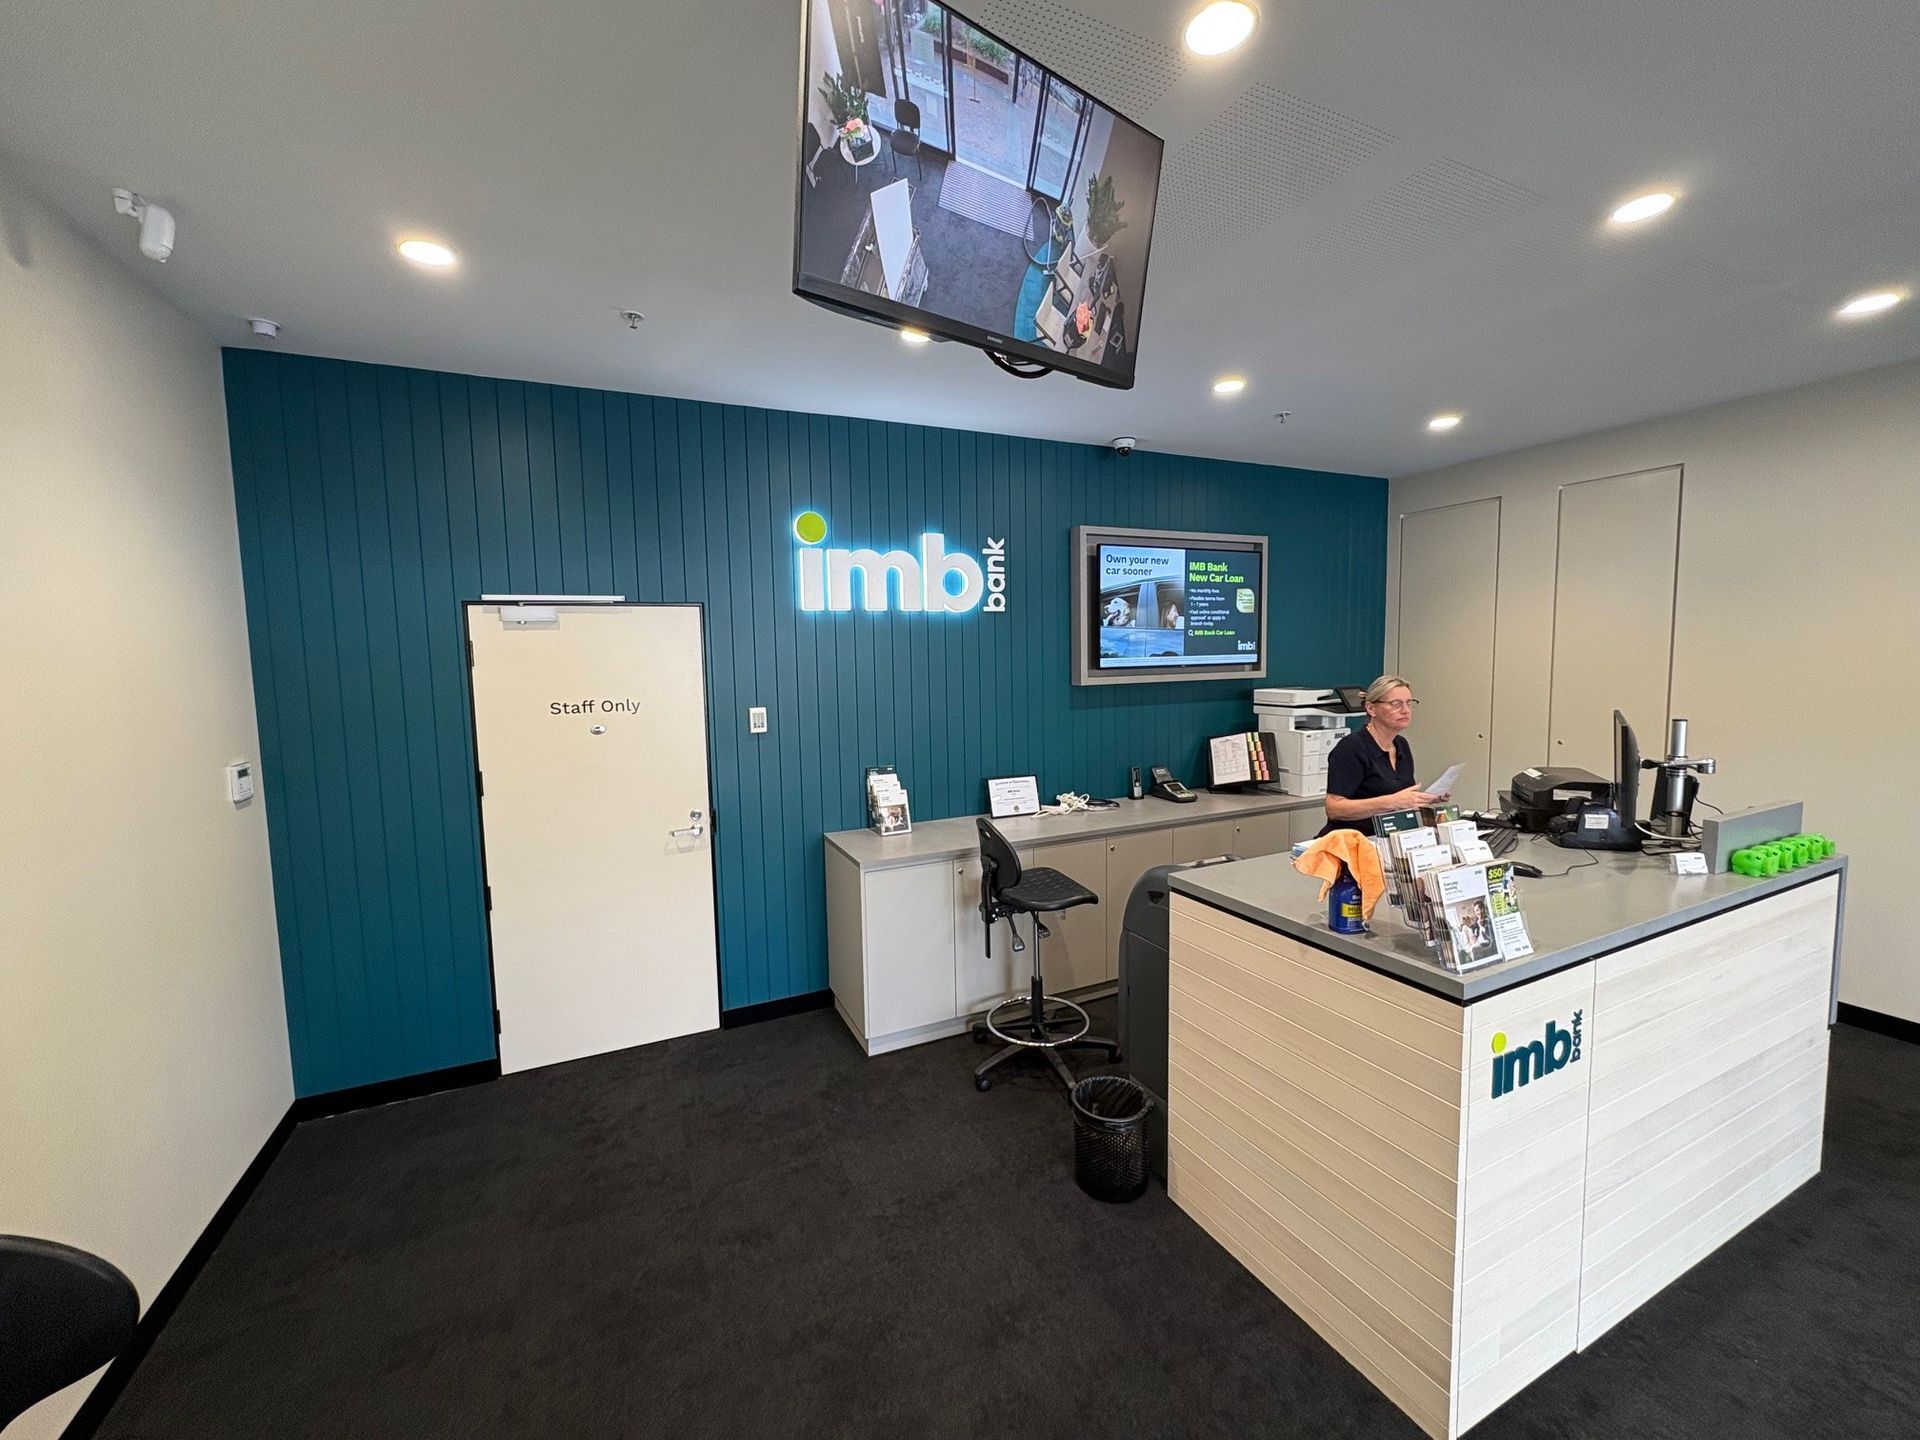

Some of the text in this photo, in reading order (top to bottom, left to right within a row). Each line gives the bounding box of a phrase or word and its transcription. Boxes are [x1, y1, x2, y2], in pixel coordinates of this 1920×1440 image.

[793, 511, 984, 613] imb
[982, 536, 1006, 612] bank
[1106, 554, 1127, 563] Own
[1129, 557, 1149, 566] your
[1190, 562, 1228, 572] IMB Bank
[1190, 573, 1244, 582] New Car Loan
[550, 698, 640, 714] Staff Only
[1570, 1009, 1583, 1063] bank
[1491, 1020, 1572, 1100] imb
